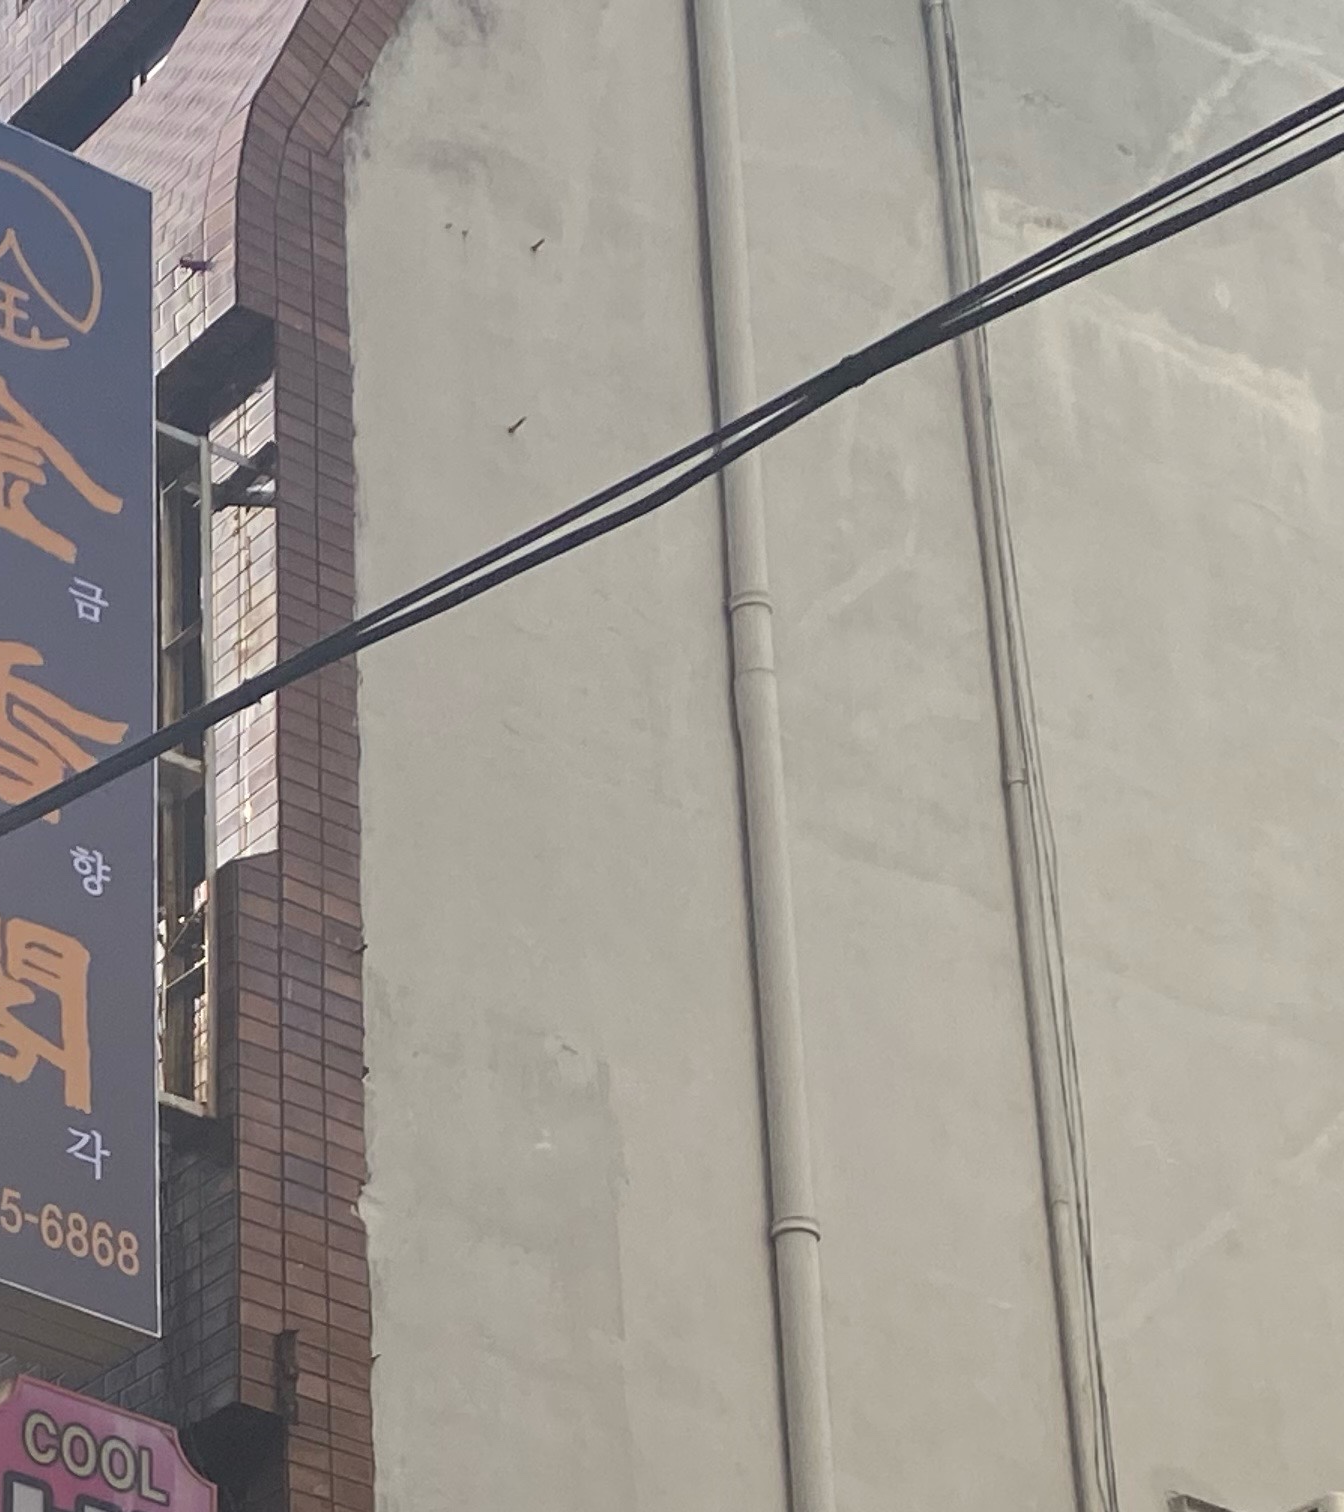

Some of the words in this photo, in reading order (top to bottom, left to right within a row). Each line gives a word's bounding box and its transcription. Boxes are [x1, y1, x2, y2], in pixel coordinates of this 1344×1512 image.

[67, 576, 109, 623] 금
[69, 845, 112, 896] 향
[65, 1126, 111, 1181] 각
[22, 1409, 171, 1506] COOL
